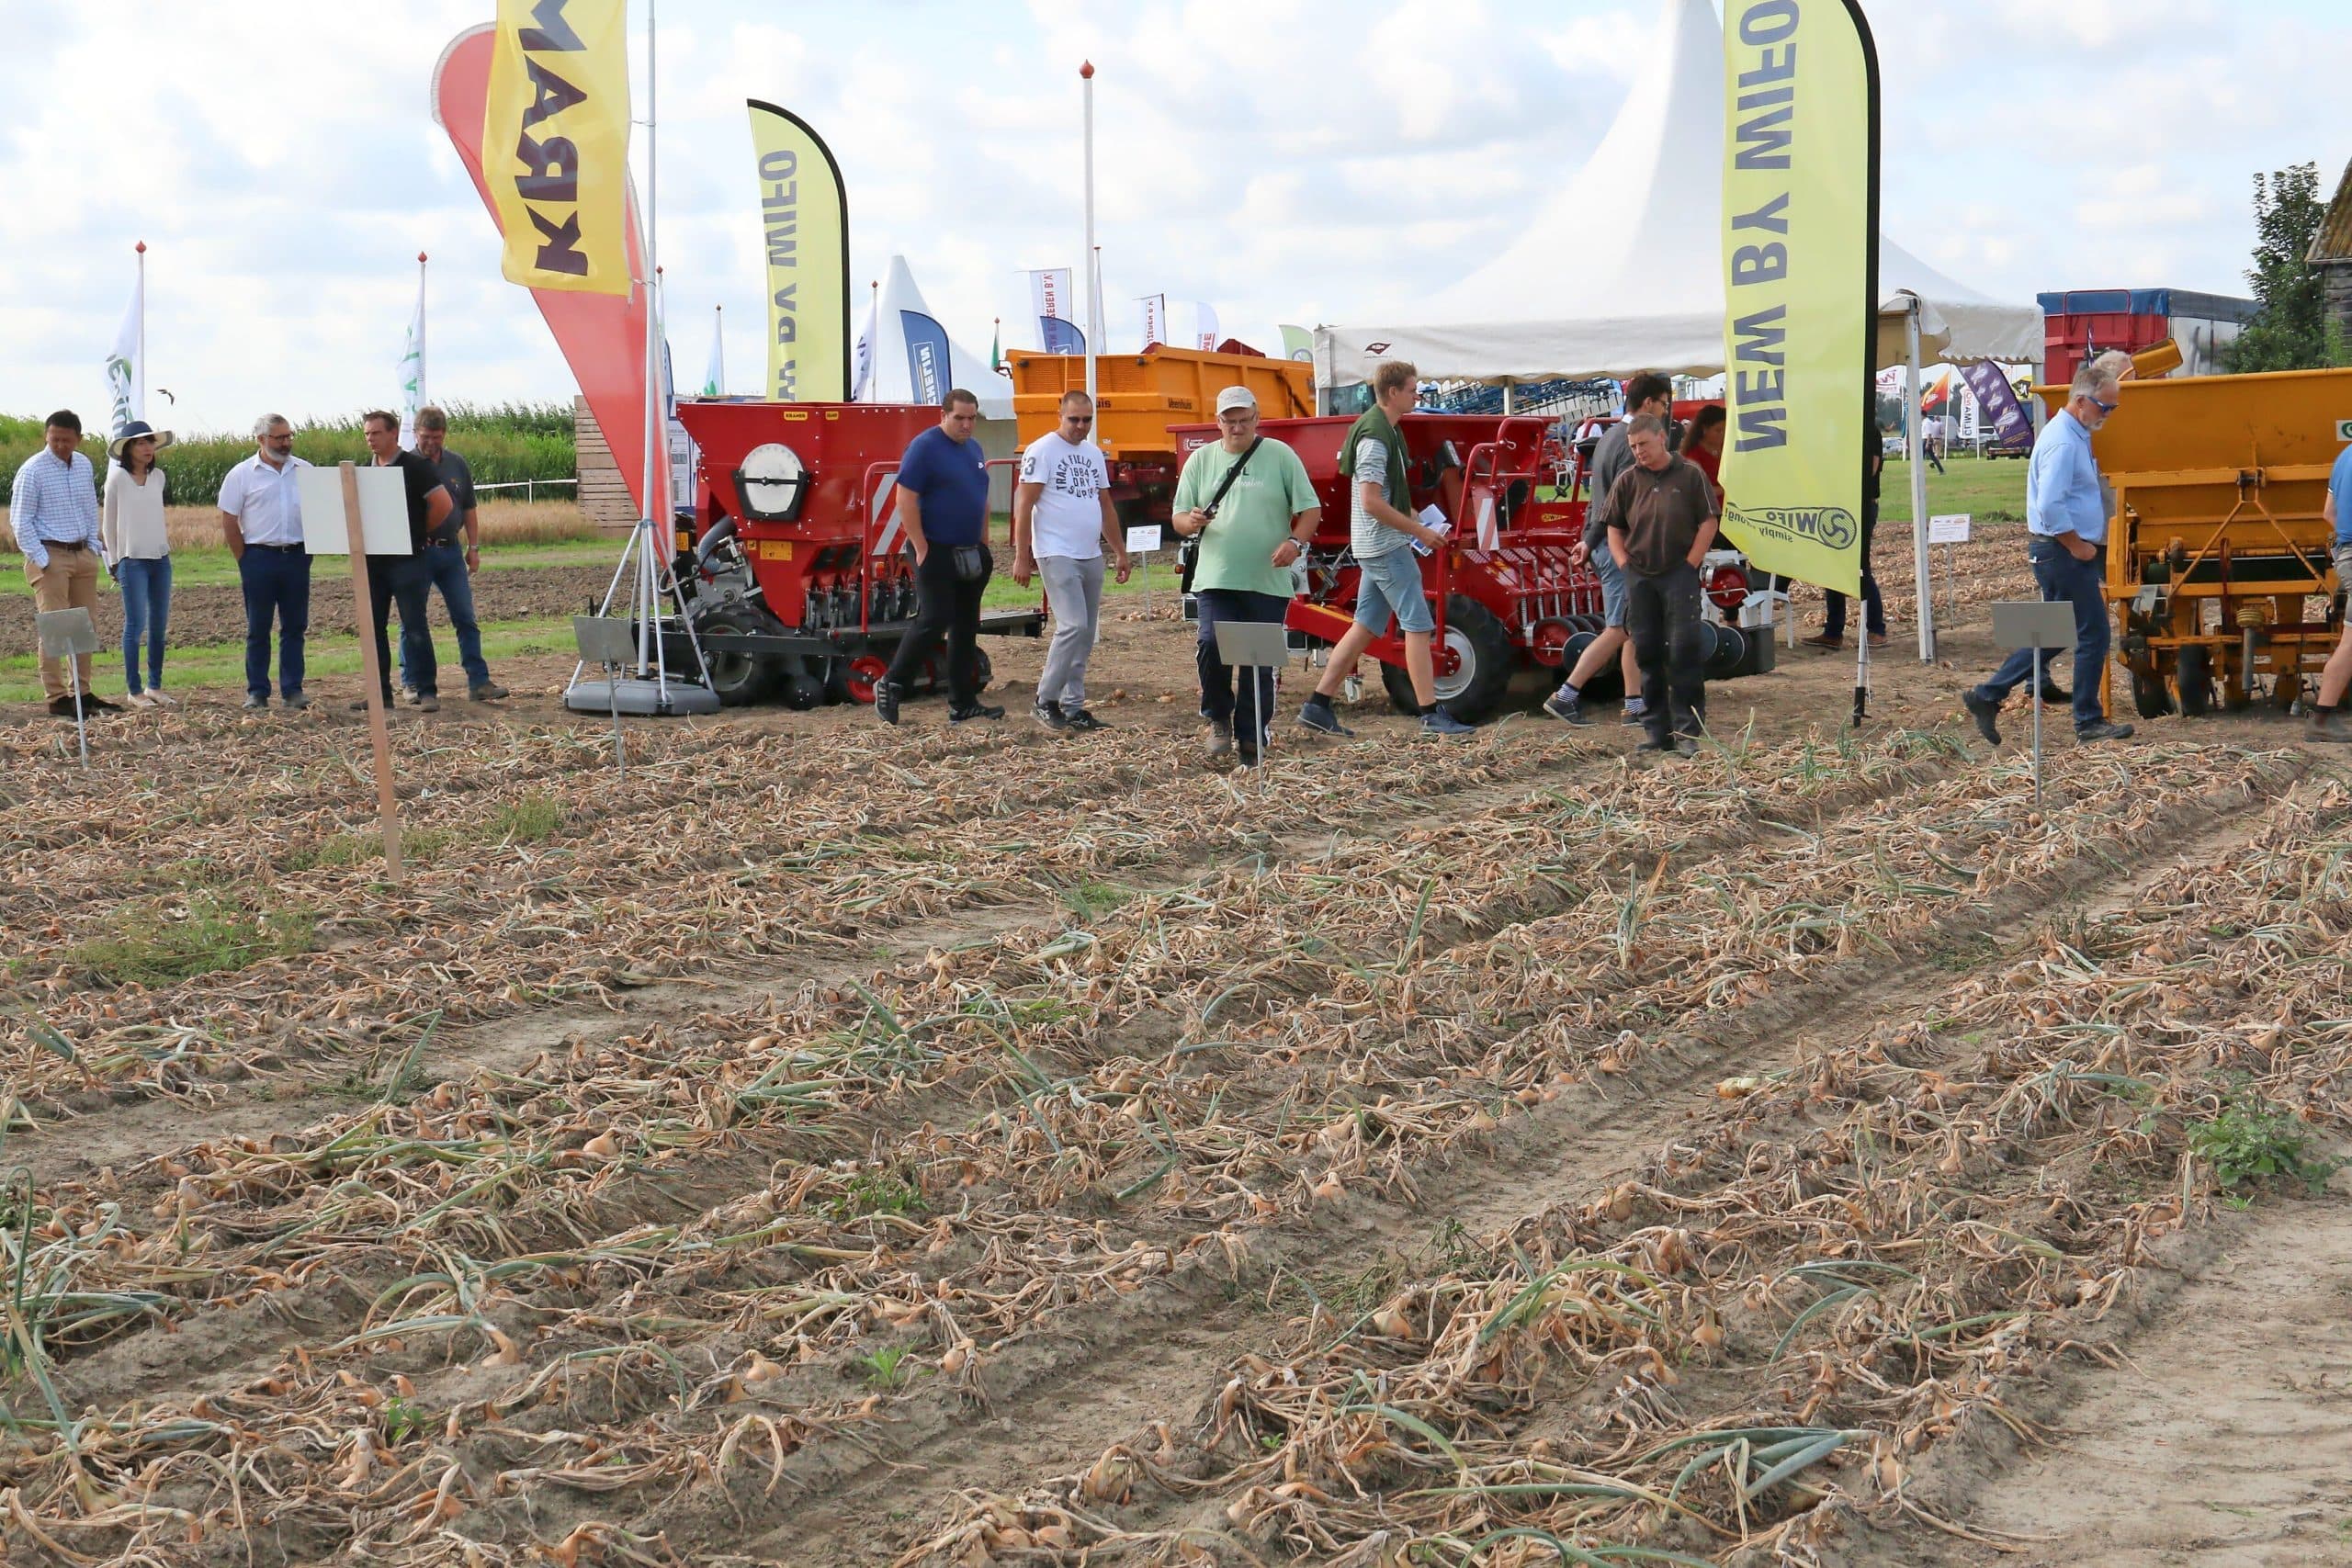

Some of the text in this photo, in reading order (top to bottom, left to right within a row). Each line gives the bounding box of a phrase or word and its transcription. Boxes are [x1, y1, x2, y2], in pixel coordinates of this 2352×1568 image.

[1056, 458, 1070, 491] TRACK
[1068, 454, 1091, 468] FIELD
[1073, 478, 1090, 487] DRY
